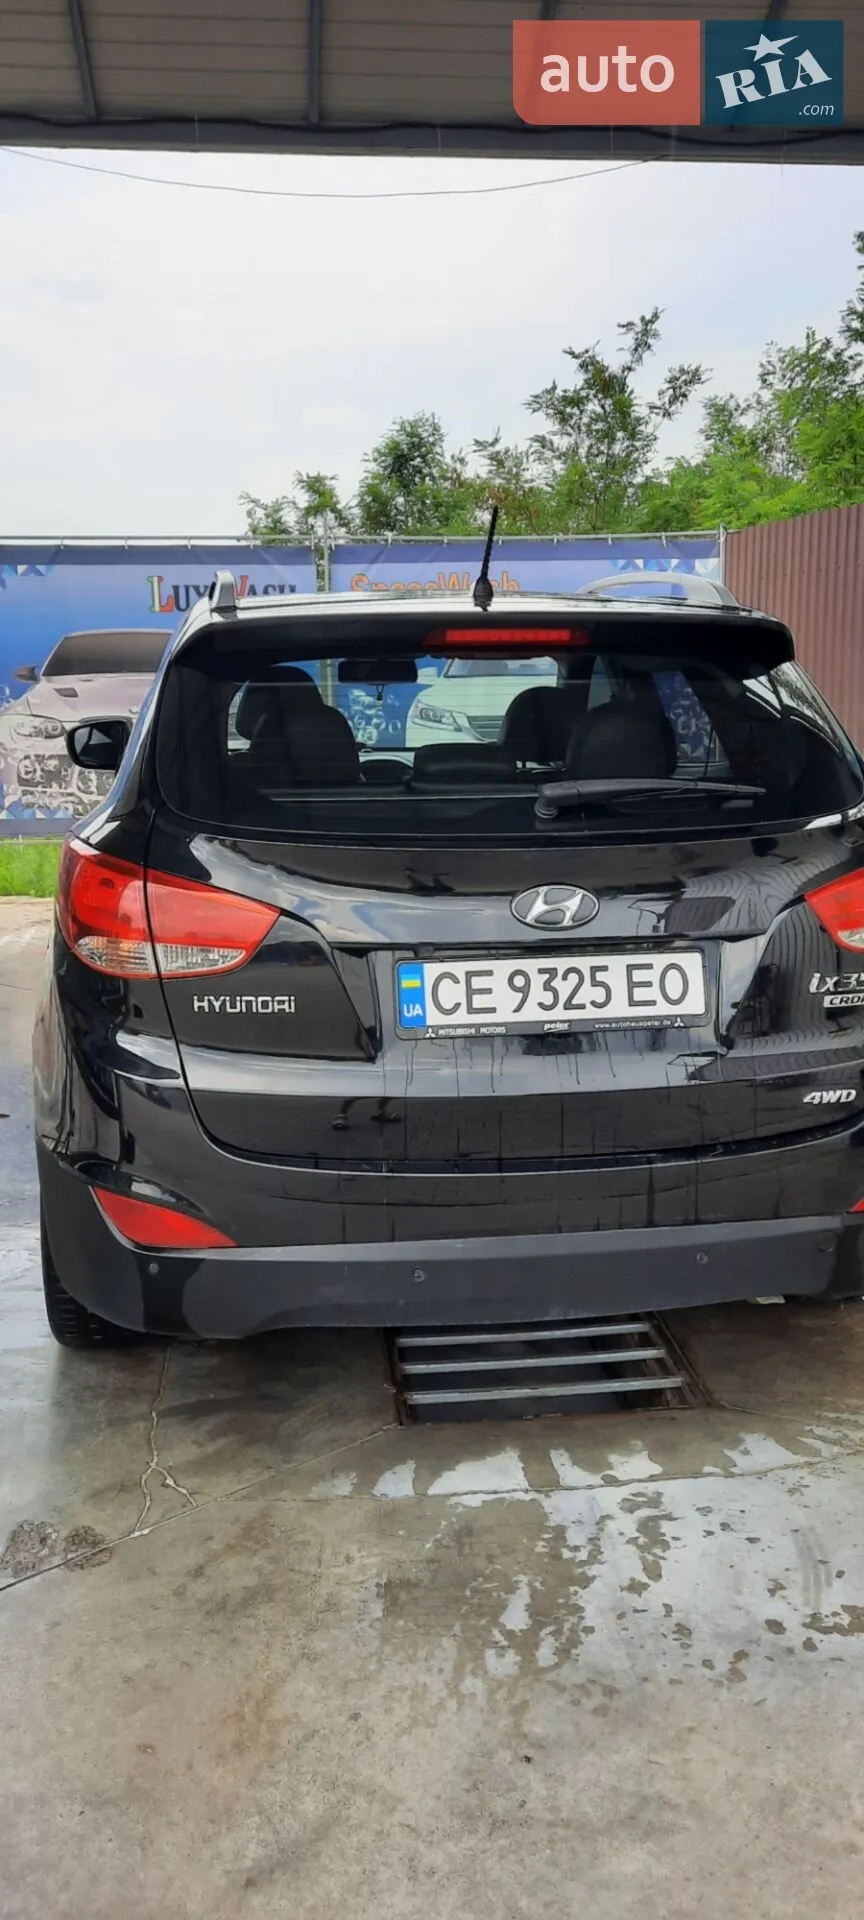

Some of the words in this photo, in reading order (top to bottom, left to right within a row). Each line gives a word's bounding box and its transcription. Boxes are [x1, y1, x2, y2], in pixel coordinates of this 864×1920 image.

[431, 969, 497, 1016] CE
[507, 965, 612, 1013] 9325
[626, 962, 690, 1007] EO
[193, 995, 296, 1013] HYUNDAI
[403, 1003, 424, 1018] UA
[438, 1027, 476, 1036] MITSUBISHI
[479, 1025, 507, 1035] MOTORS
[803, 1089, 857, 1104] 4WD
